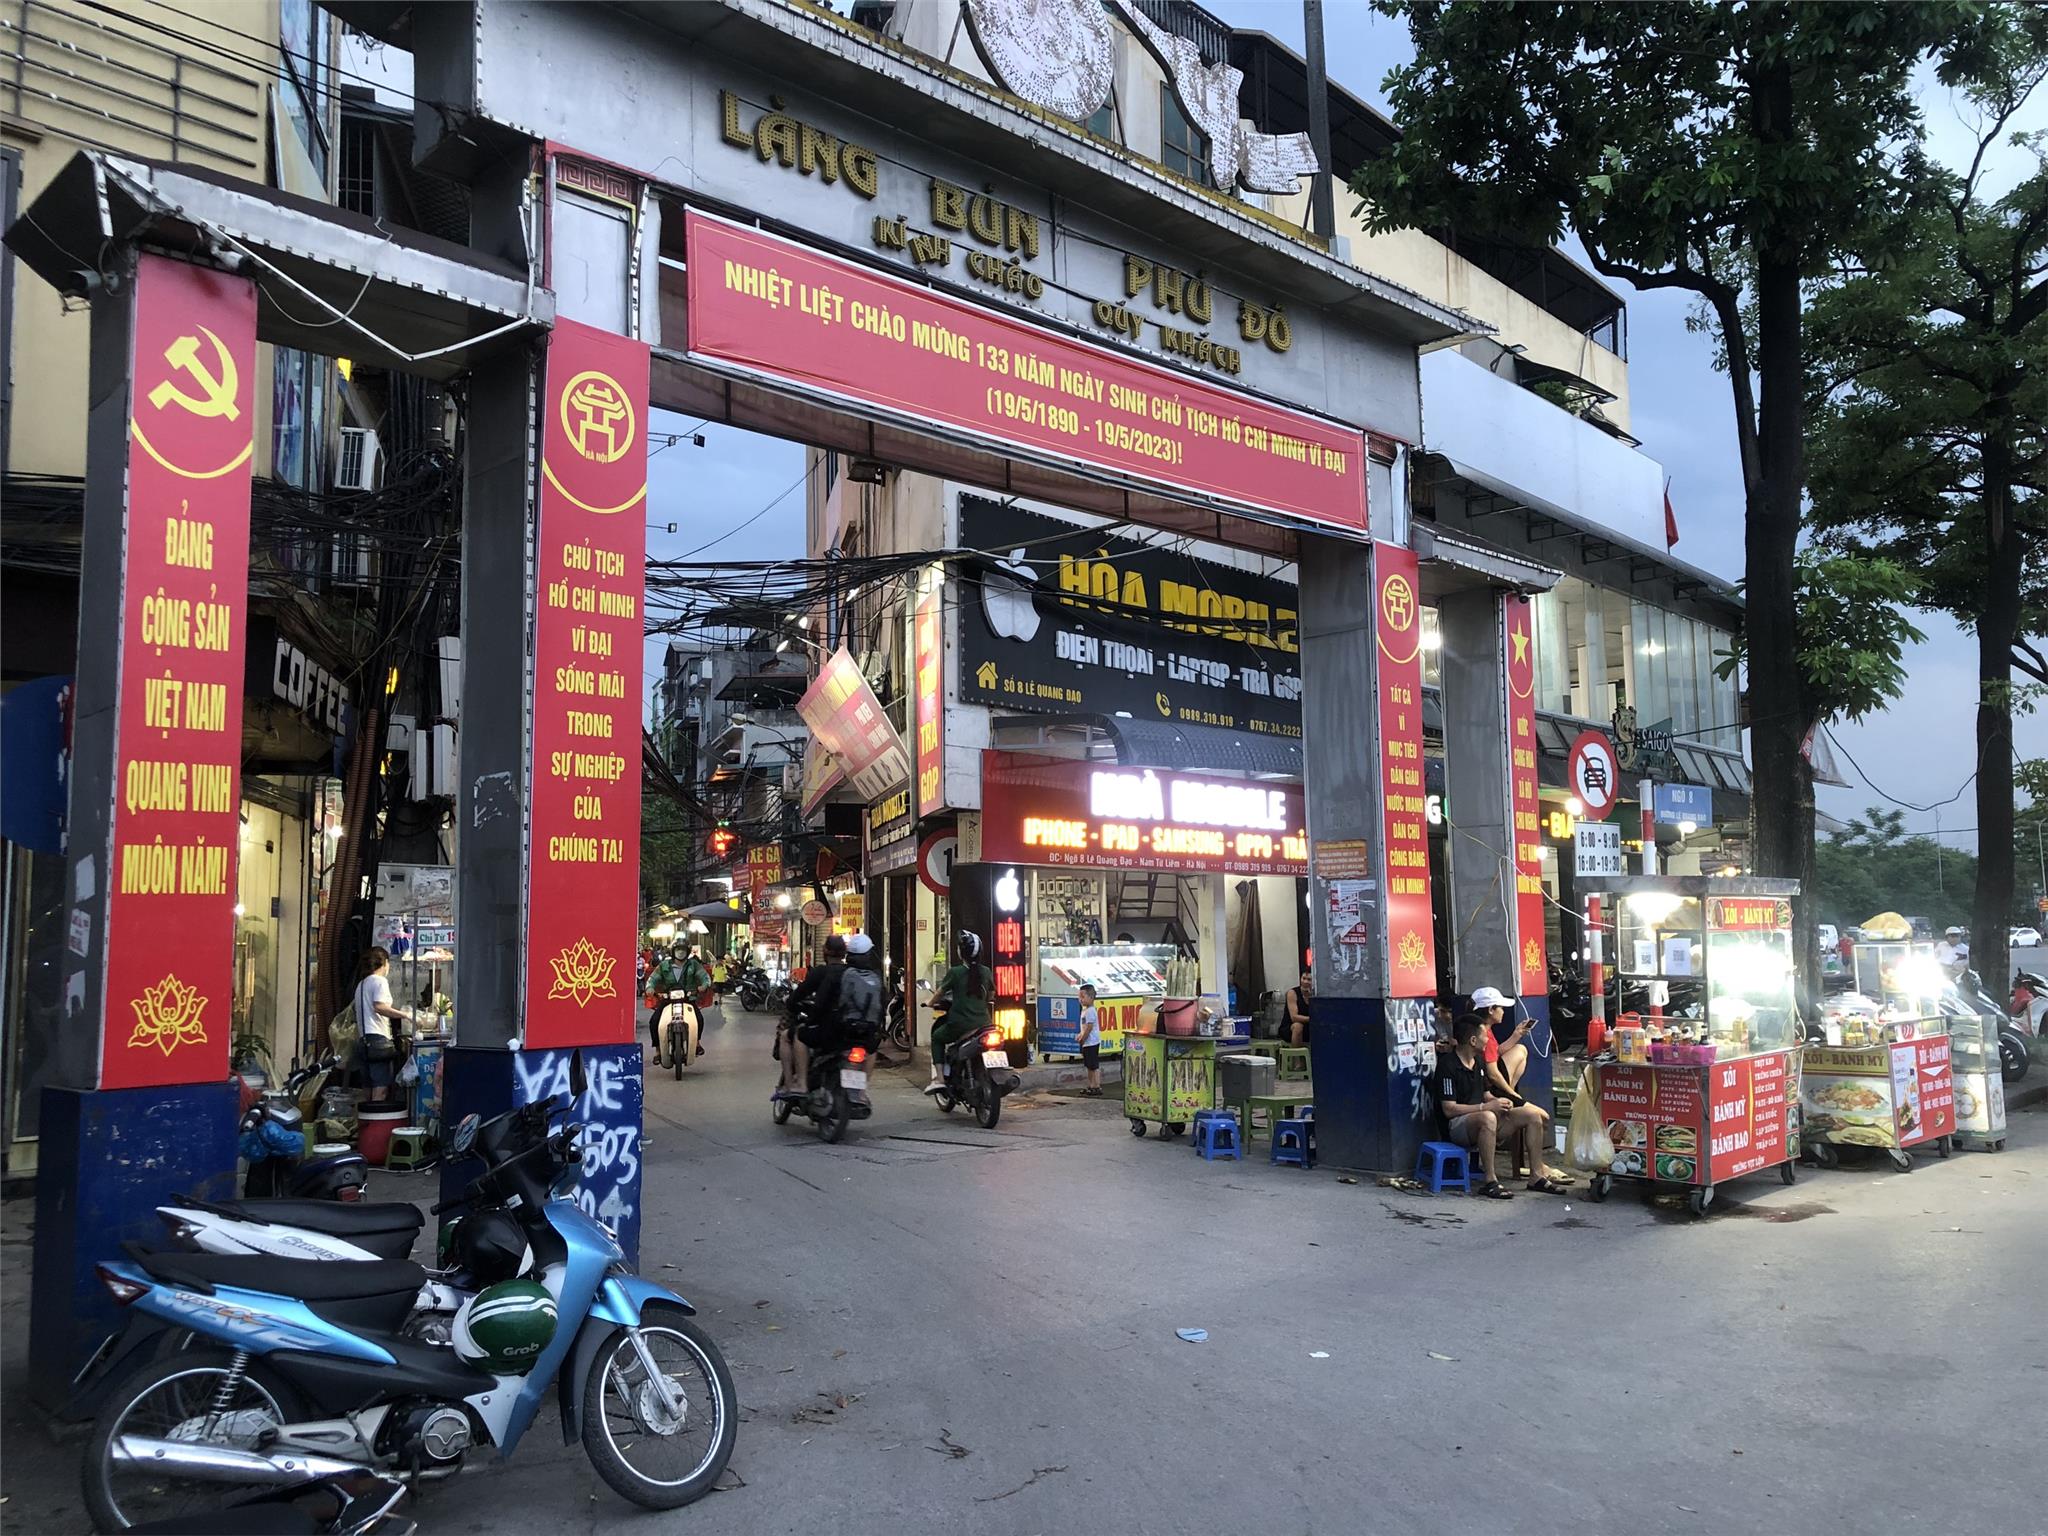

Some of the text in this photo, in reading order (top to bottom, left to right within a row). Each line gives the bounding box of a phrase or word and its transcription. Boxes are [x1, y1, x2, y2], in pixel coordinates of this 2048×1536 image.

[725, 260, 1346, 477] NHIỆT LIỆT CHÀO MỪNG 133 NĂM NGÀY SINH CHỦ TỊCH HỒ CHÍ MINH VĨ ĐẠI
[986, 388, 1183, 465] (19/5/1890 19/5/2023)!
[165, 499, 214, 570] ĐẢNG
[563, 537, 625, 579] CHỦ TỊCH
[548, 577, 635, 619] HỒ CHÍ MINH
[142, 583, 231, 656] CỘNG SẢN
[571, 624, 612, 661] VĨ ĐẠI
[1055, 624, 1099, 669] ĐIỆN
[1102, 639, 1154, 679] THOẠI
[1167, 652, 1231, 689] LAPTOP
[1240, 660, 1270, 697] TRẢ
[273, 637, 349, 736] COFFEE
[555, 661, 625, 699] SỐNG MÃI
[1003, 674, 1015, 693] SỐ
[1017, 681, 1024, 694] 8
[1025, 680, 1035, 696] LÊ
[1037, 683, 1063, 700] QUANG
[145, 669, 226, 739] VIỆT NAM
[566, 710, 613, 738] TRONG
[920, 715, 938, 756] TRẢ
[1388, 740, 1403, 760] MỤC
[126, 760, 232, 815] QUANG VINH
[551, 750, 626, 785] SỰ NGHIỆP
[920, 763, 939, 804] GÓP
[573, 786, 602, 821] CỦA
[549, 832, 623, 864] CHÚNG TA!
[1023, 817, 1088, 848] IPHONE
[1101, 823, 1139, 851] IPAD
[1152, 826, 1225, 856] SAMSUNG
[1235, 832, 1272, 859] OPPO
[1581, 831, 1619, 849] 6:00 9:00
[121, 834, 228, 895] MUÔN NĂM!
[1079, 854, 1085, 863] 8
[1096, 854, 1118, 866] Quang
[1140, 857, 1154, 867] Nam
[1291, 864, 1298, 873] 34
[1578, 855, 1595, 872] 16:00
[997, 917, 1021, 958] ĐIỆN
[996, 965, 1024, 1001] THOẠI
[503, 1342, 540, 1356] Grab
